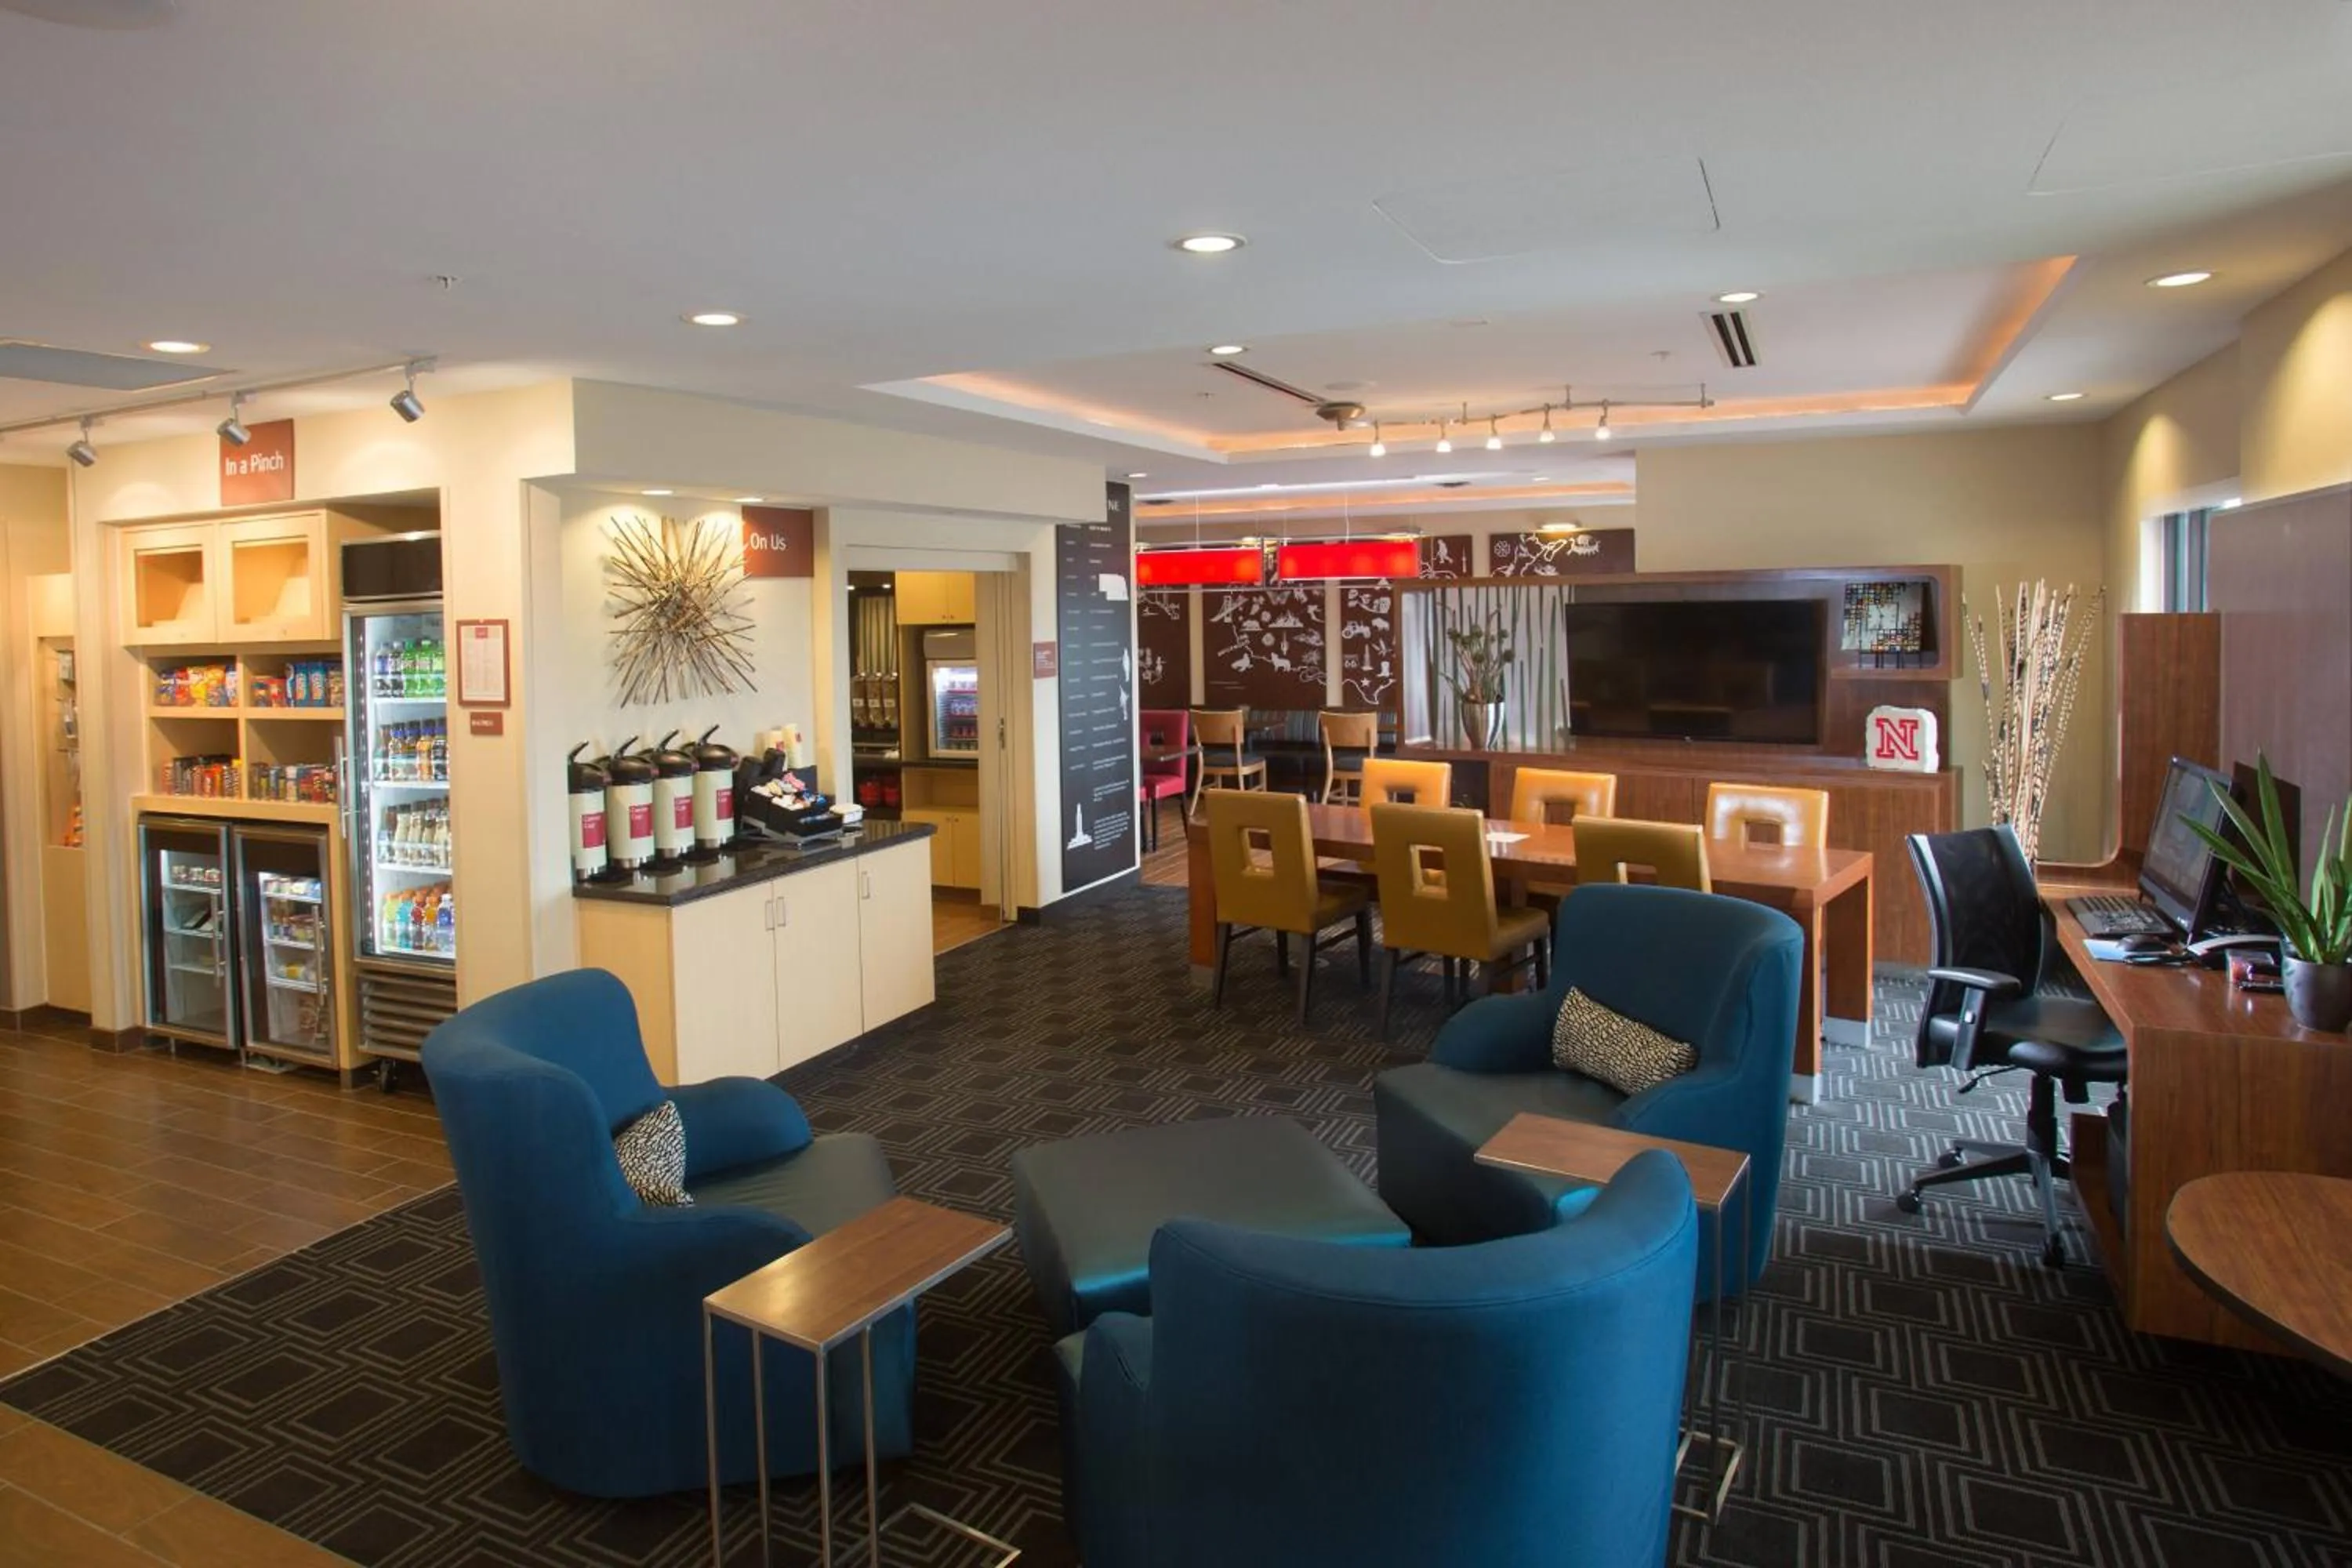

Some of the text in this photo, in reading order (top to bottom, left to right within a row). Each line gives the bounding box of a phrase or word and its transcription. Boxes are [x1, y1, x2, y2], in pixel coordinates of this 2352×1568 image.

[225, 450, 284, 476] In a Pinch
[750, 532, 787, 551] On Us
[1875, 717, 1919, 760] N
